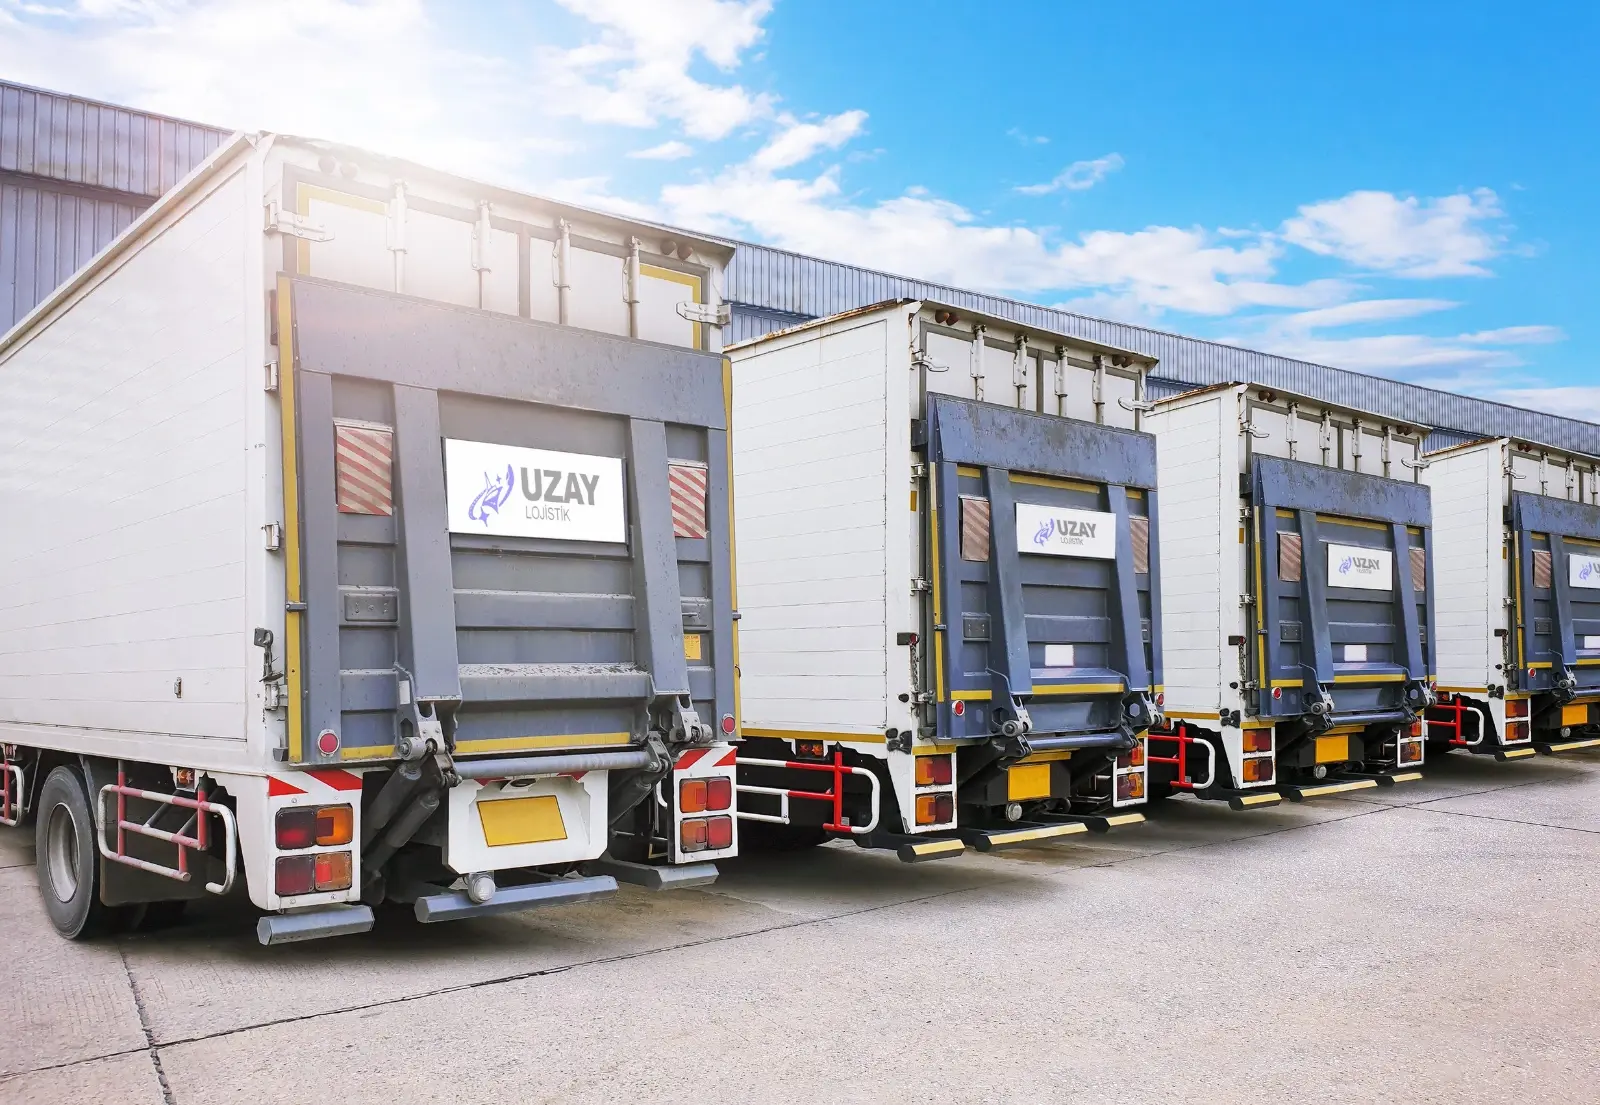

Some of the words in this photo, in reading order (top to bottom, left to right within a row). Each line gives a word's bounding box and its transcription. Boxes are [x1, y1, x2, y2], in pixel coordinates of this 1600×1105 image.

[520, 467, 600, 506] UZAY
[1056, 519, 1097, 539] UZAY
[1352, 556, 1381, 570] UZAY
